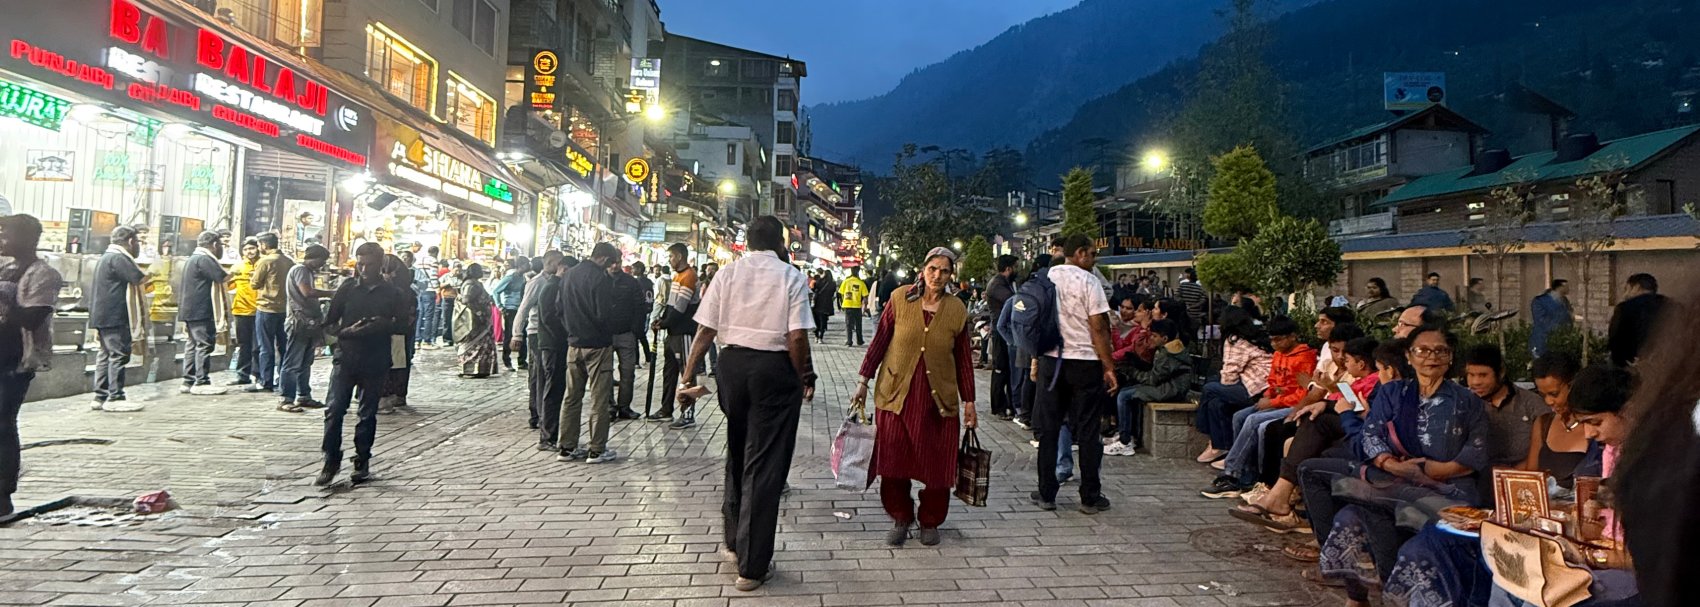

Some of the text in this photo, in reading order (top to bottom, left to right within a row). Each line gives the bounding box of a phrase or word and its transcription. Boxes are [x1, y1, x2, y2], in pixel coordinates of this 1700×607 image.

[10, 39, 114, 90] PUNJABI
[197, 27, 328, 117] BALAJI
[1119, 236, 1144, 248] HIM
